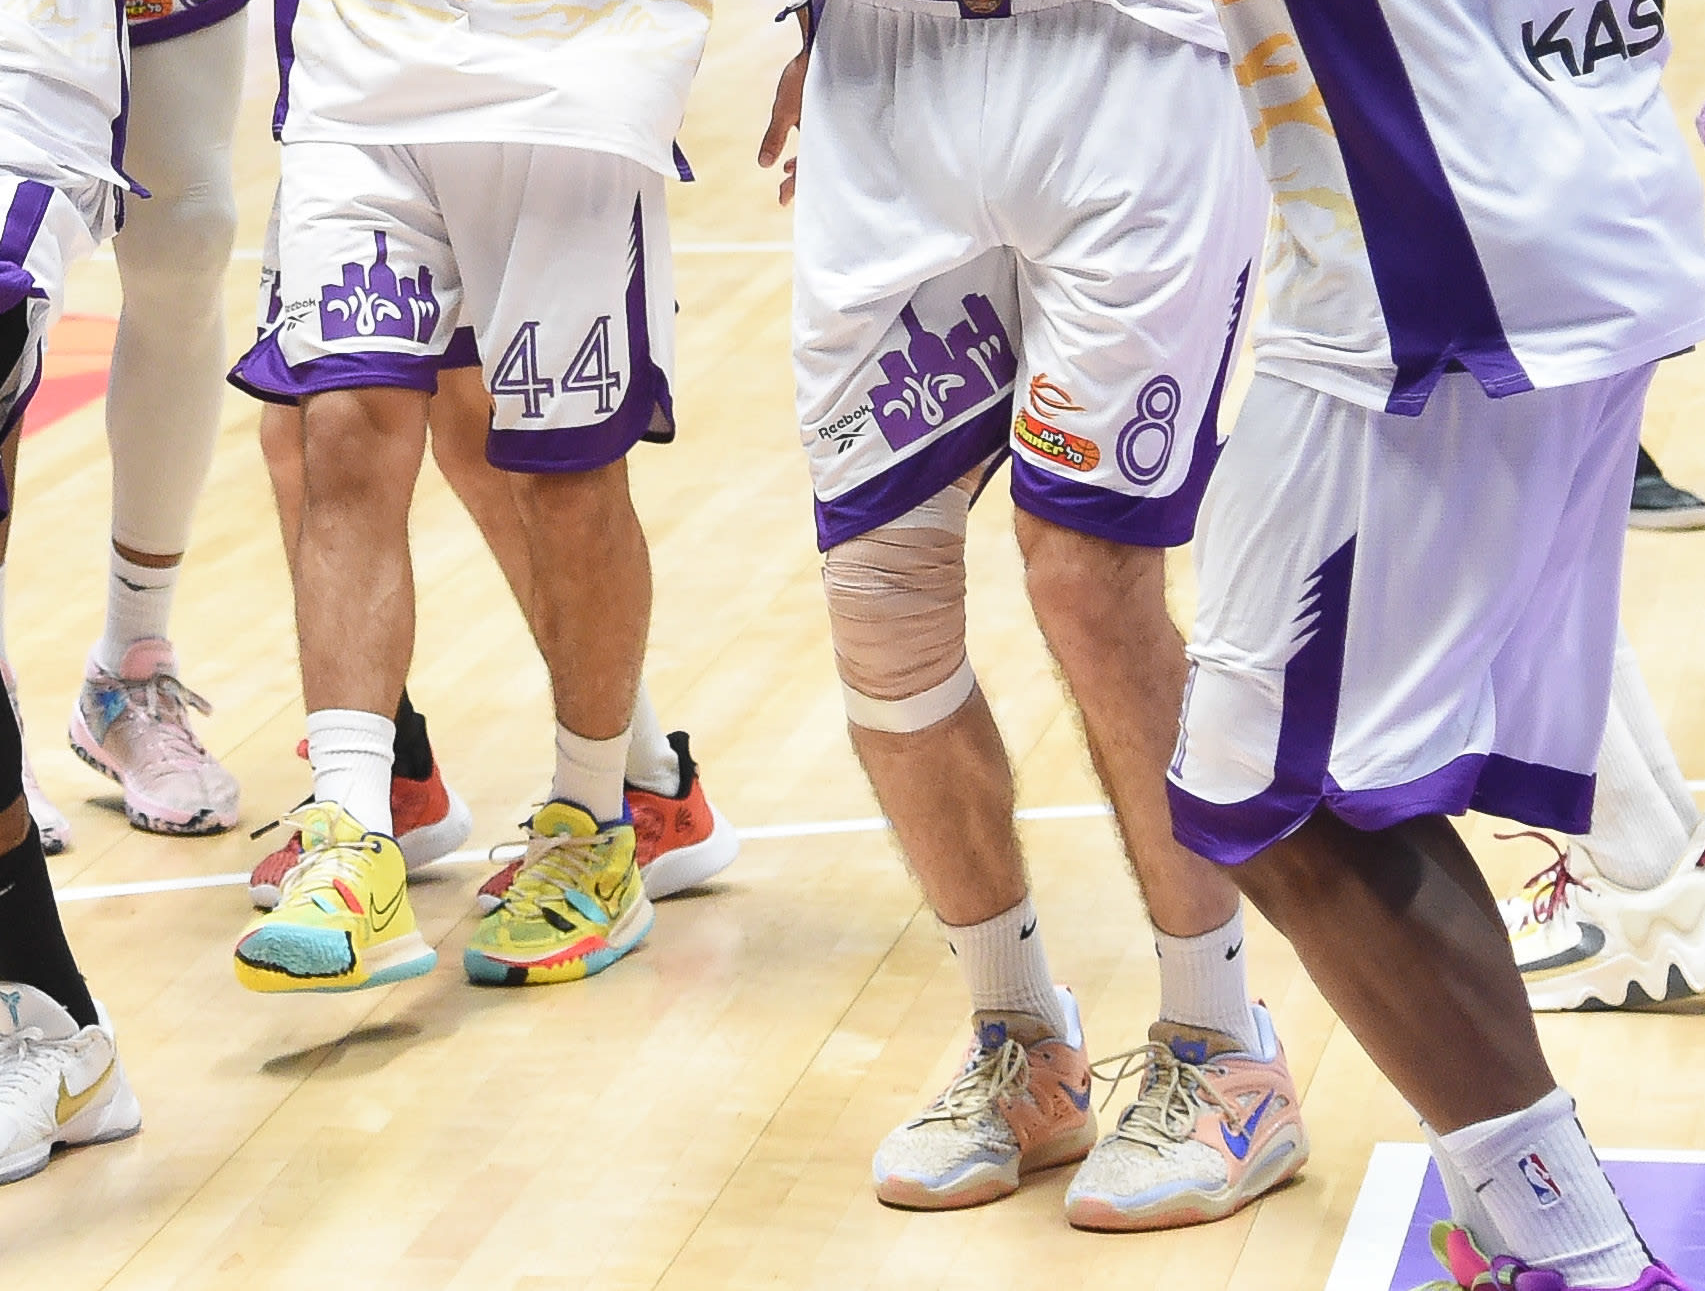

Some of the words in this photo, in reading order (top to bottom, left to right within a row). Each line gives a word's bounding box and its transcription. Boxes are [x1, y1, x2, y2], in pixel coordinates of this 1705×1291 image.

[490, 315, 621, 419] 44
[817, 403, 873, 440] Reebok
[1115, 374, 1182, 487] 8
